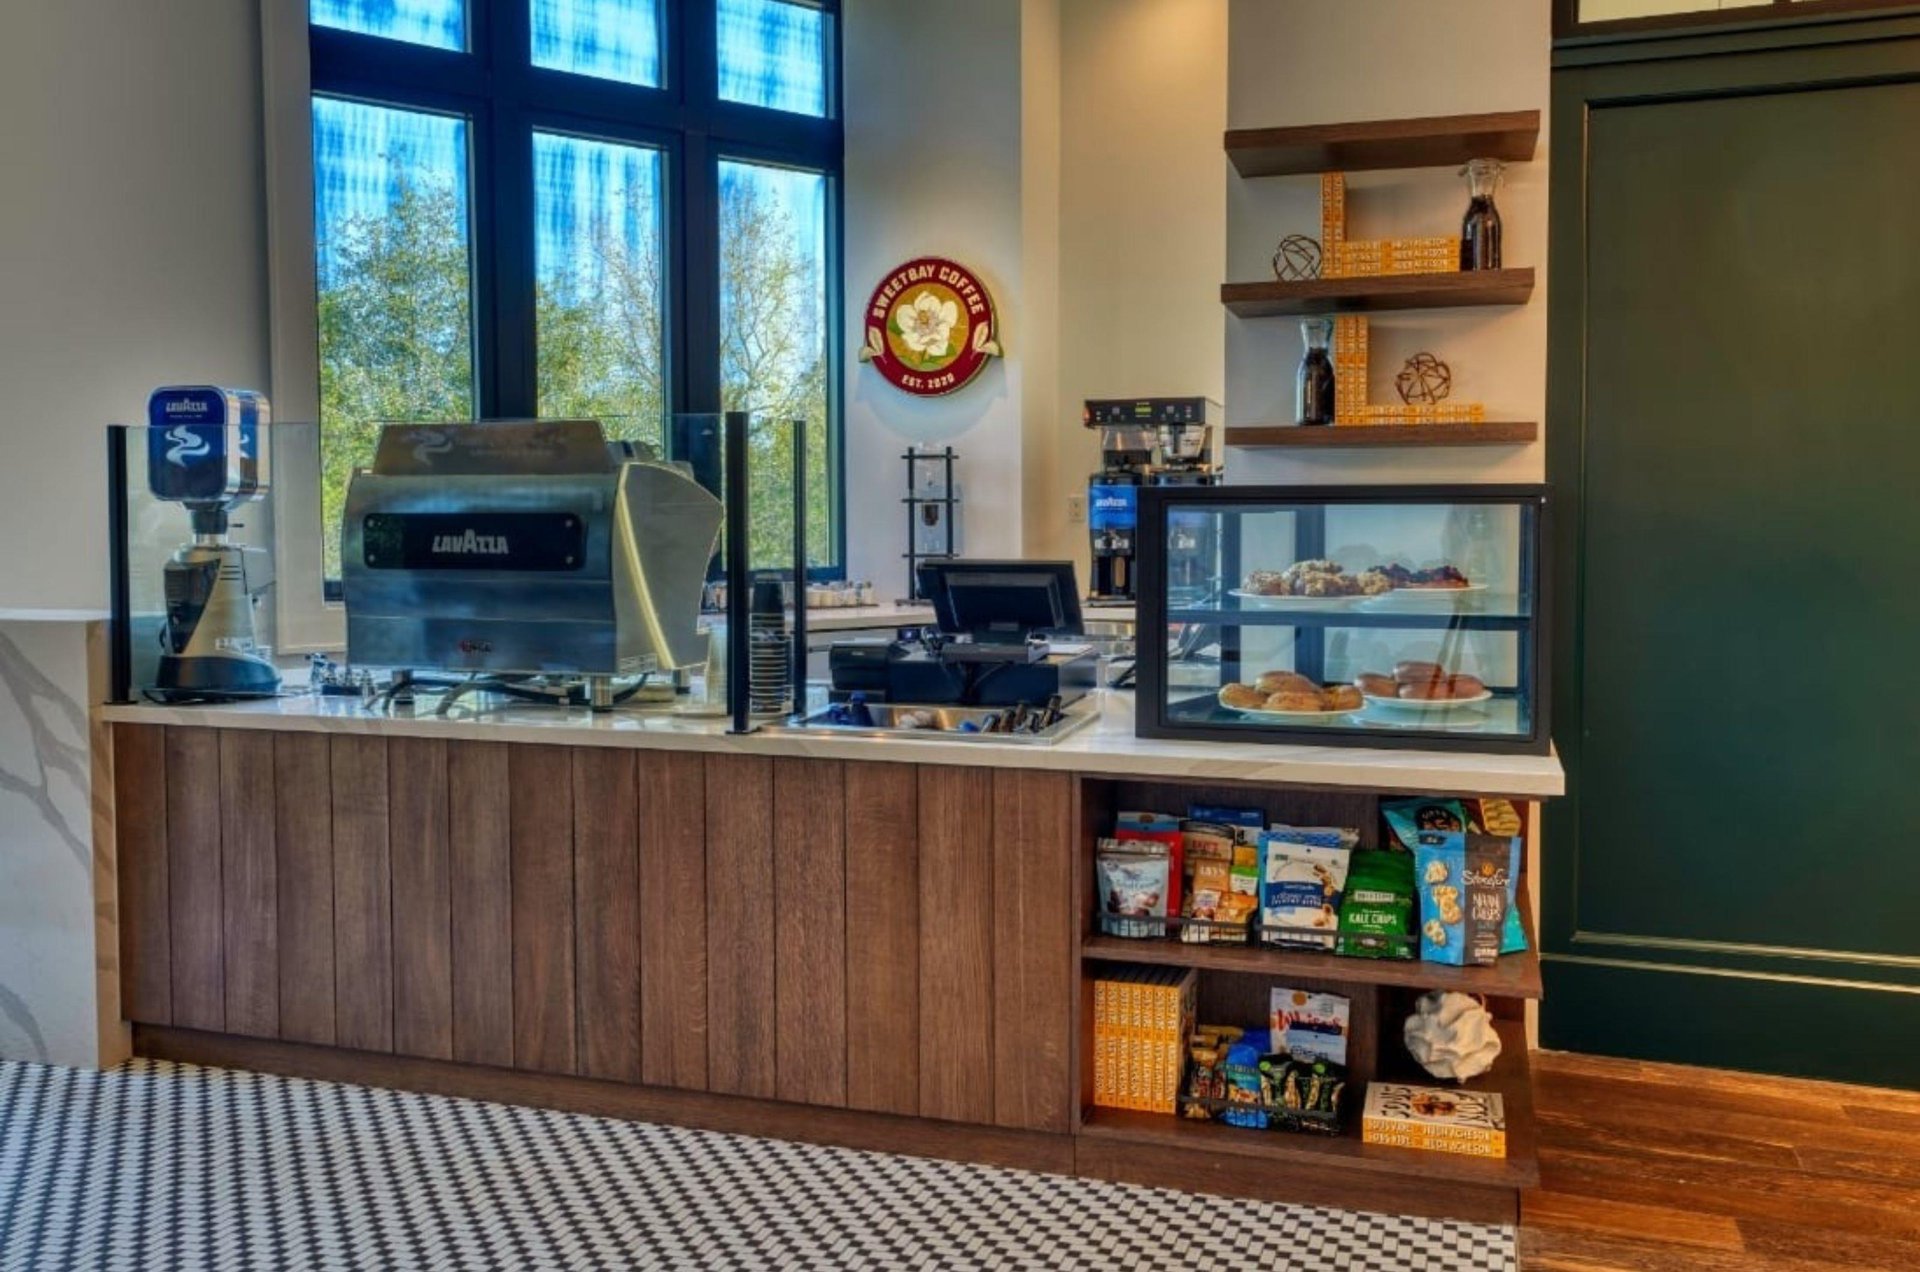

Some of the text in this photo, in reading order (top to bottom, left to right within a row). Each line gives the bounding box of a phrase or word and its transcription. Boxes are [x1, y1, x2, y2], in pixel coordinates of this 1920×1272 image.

[873, 265, 984, 319] SWEETBAY COFFEE
[901, 374, 924, 389] EST.
[166, 397, 208, 413] LAVAZZA
[431, 528, 509, 554] LAVAZZA
[1349, 913, 1397, 926] KALE CHIPS
